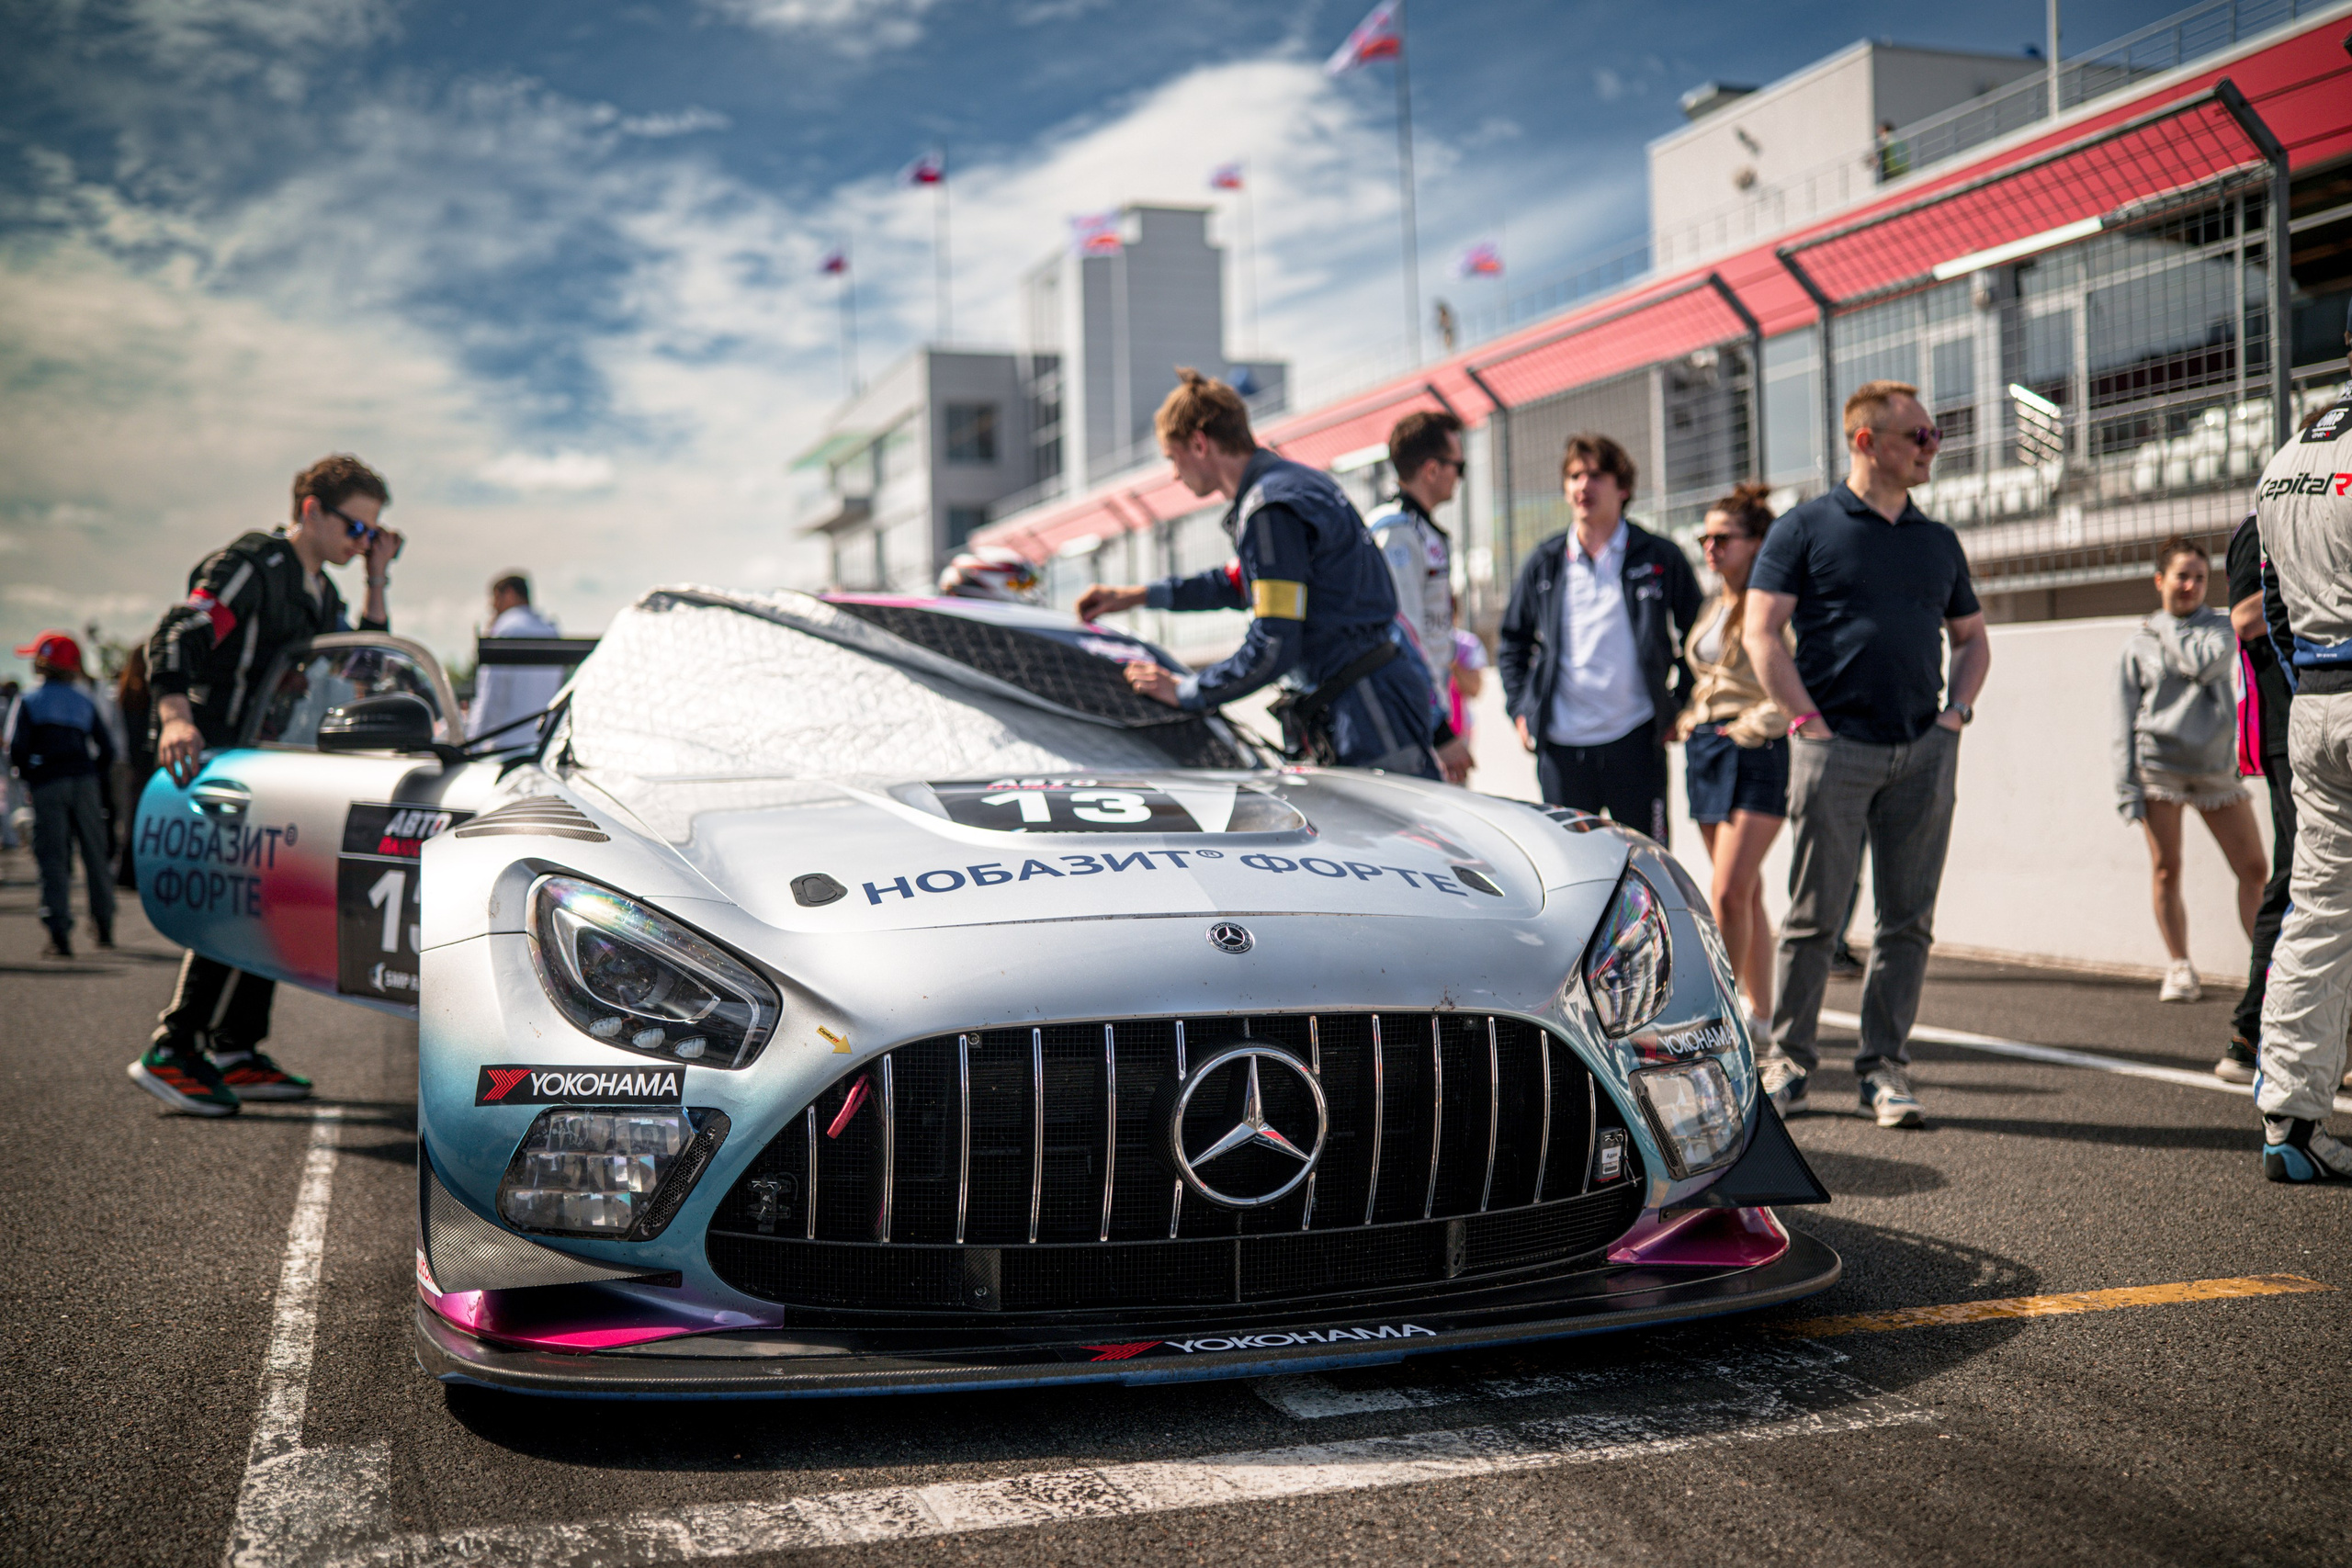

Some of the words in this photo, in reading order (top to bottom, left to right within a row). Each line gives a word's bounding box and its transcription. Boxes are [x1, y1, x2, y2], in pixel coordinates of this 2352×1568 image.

[2259, 472, 2352, 502] CapitalR
[981, 791, 1151, 823] 13
[384, 809, 453, 840] АВТО
[1240, 853, 1468, 897] ФОРТЕ
[154, 865, 262, 918] ФОРТЕ
[368, 870, 420, 955] 1
[1658, 1024, 1736, 1055] YOKOHAMA
[531, 1072, 679, 1097] YOKOHAMA
[1165, 1324, 1436, 1353] YOKOHAMA
